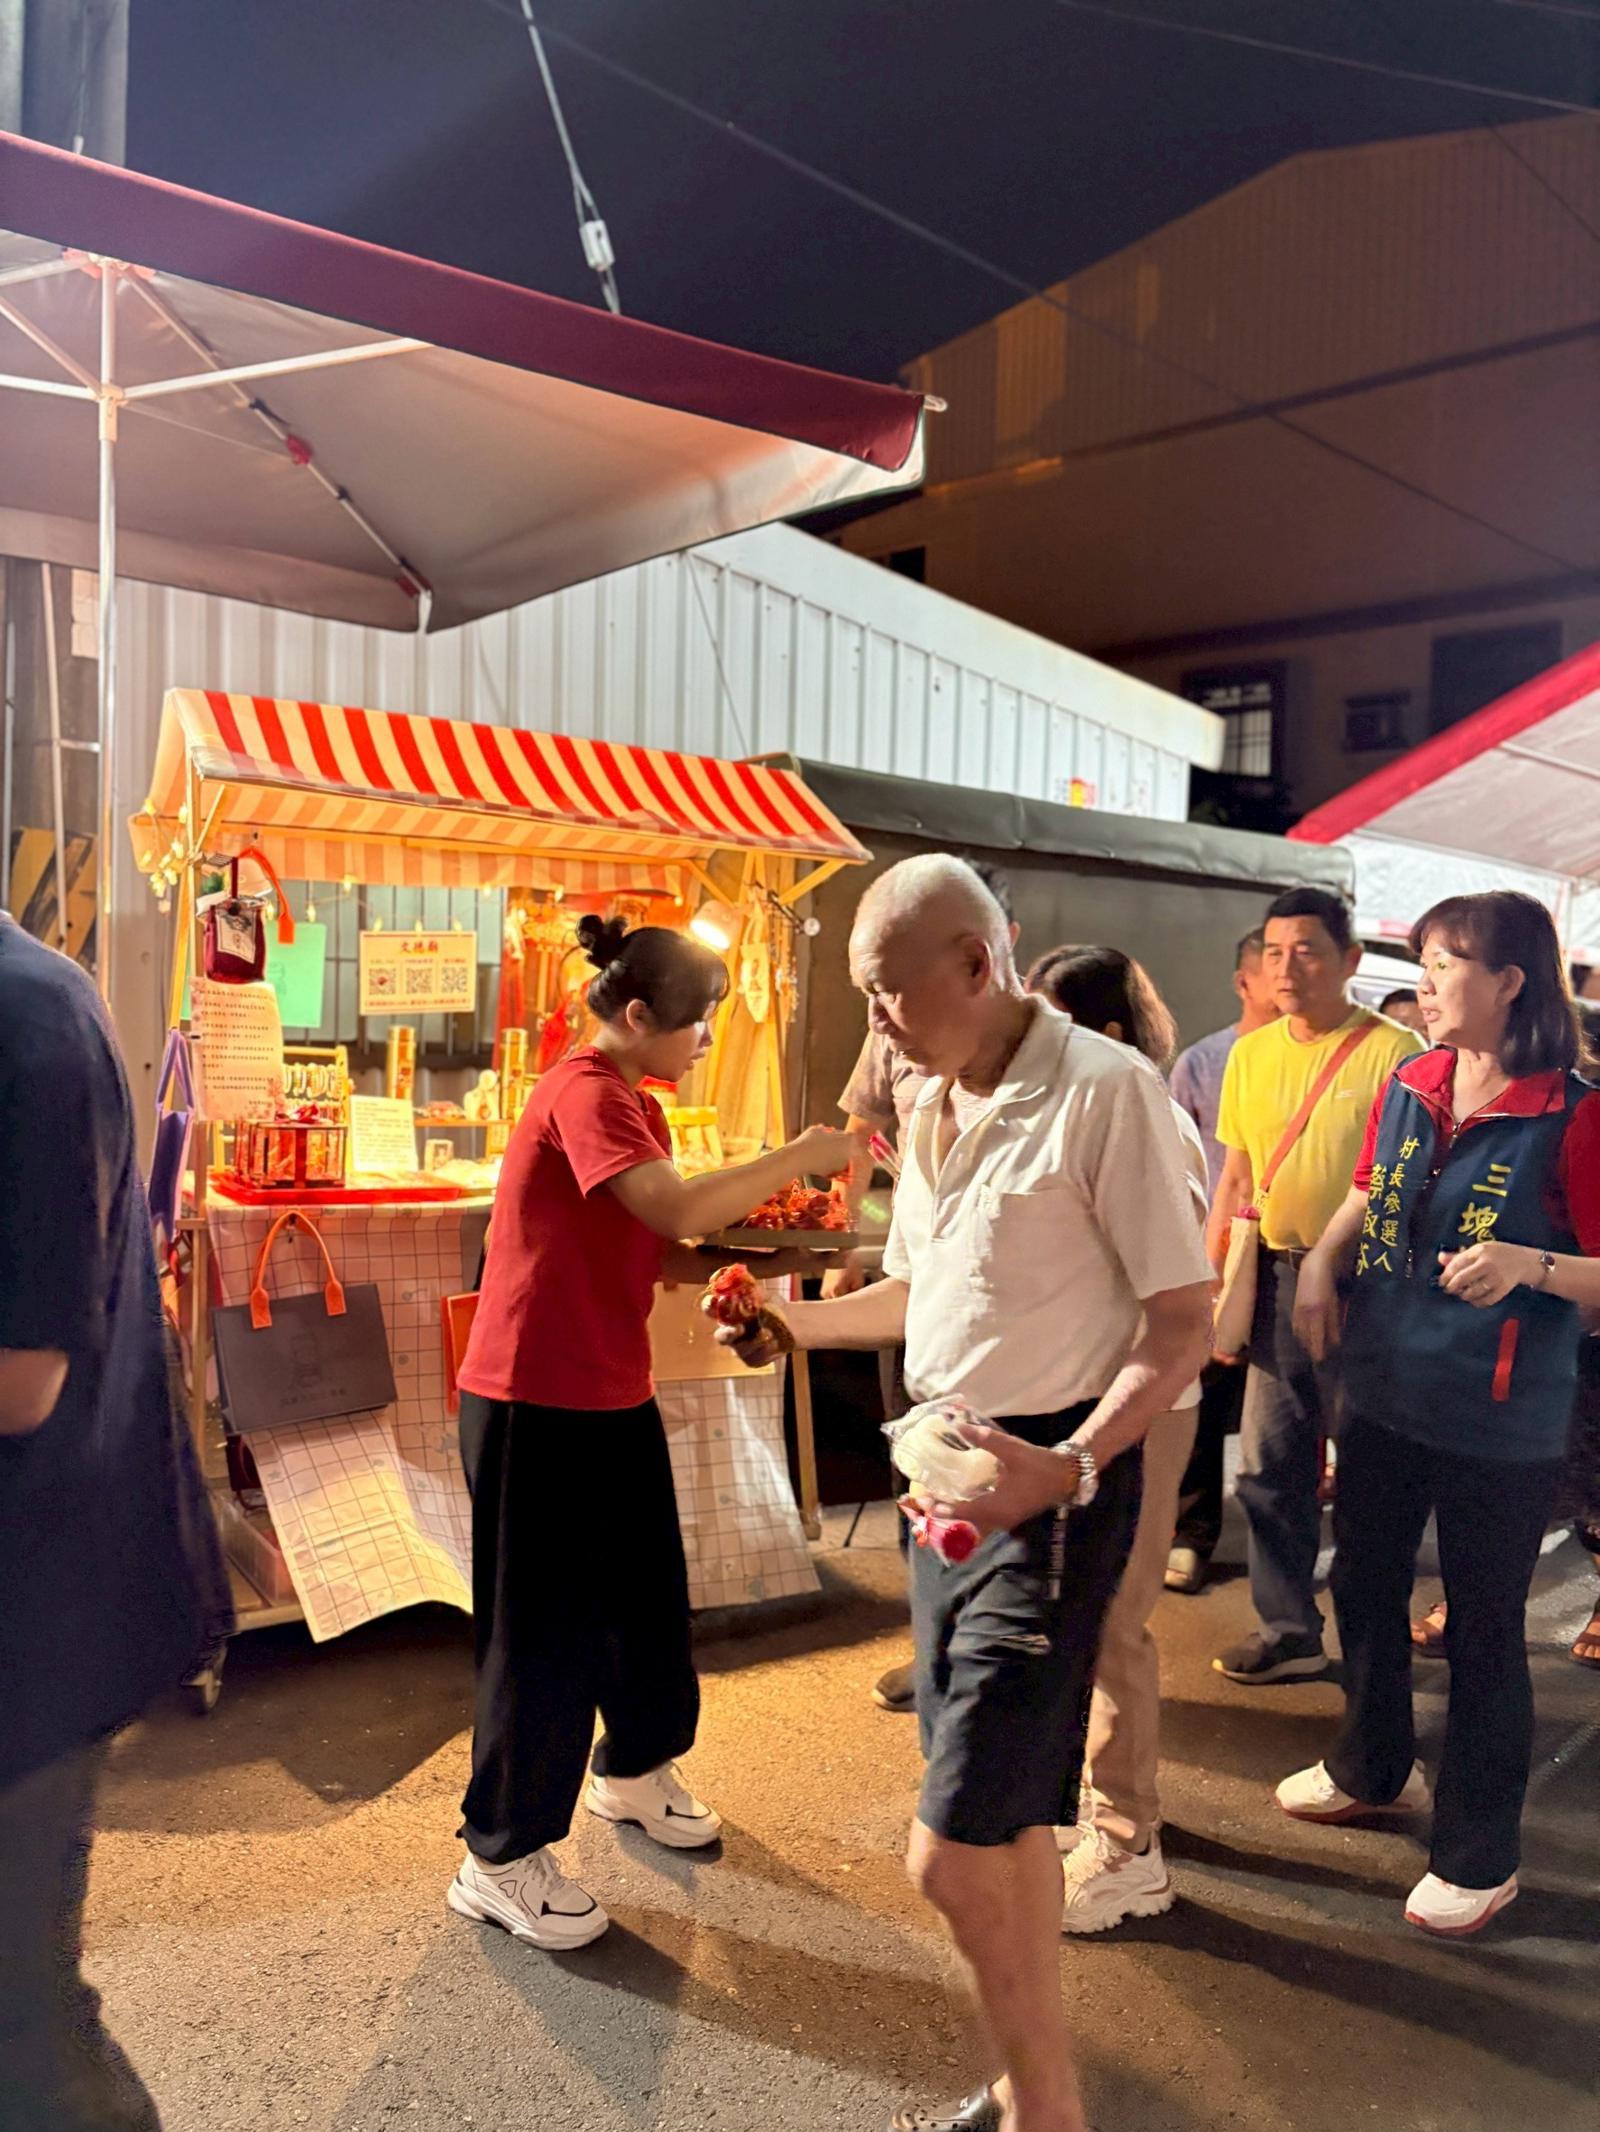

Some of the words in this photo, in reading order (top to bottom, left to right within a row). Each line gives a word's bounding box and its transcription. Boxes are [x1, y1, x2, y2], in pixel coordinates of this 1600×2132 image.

[1373, 1135, 1420, 1272] 村長參選人
